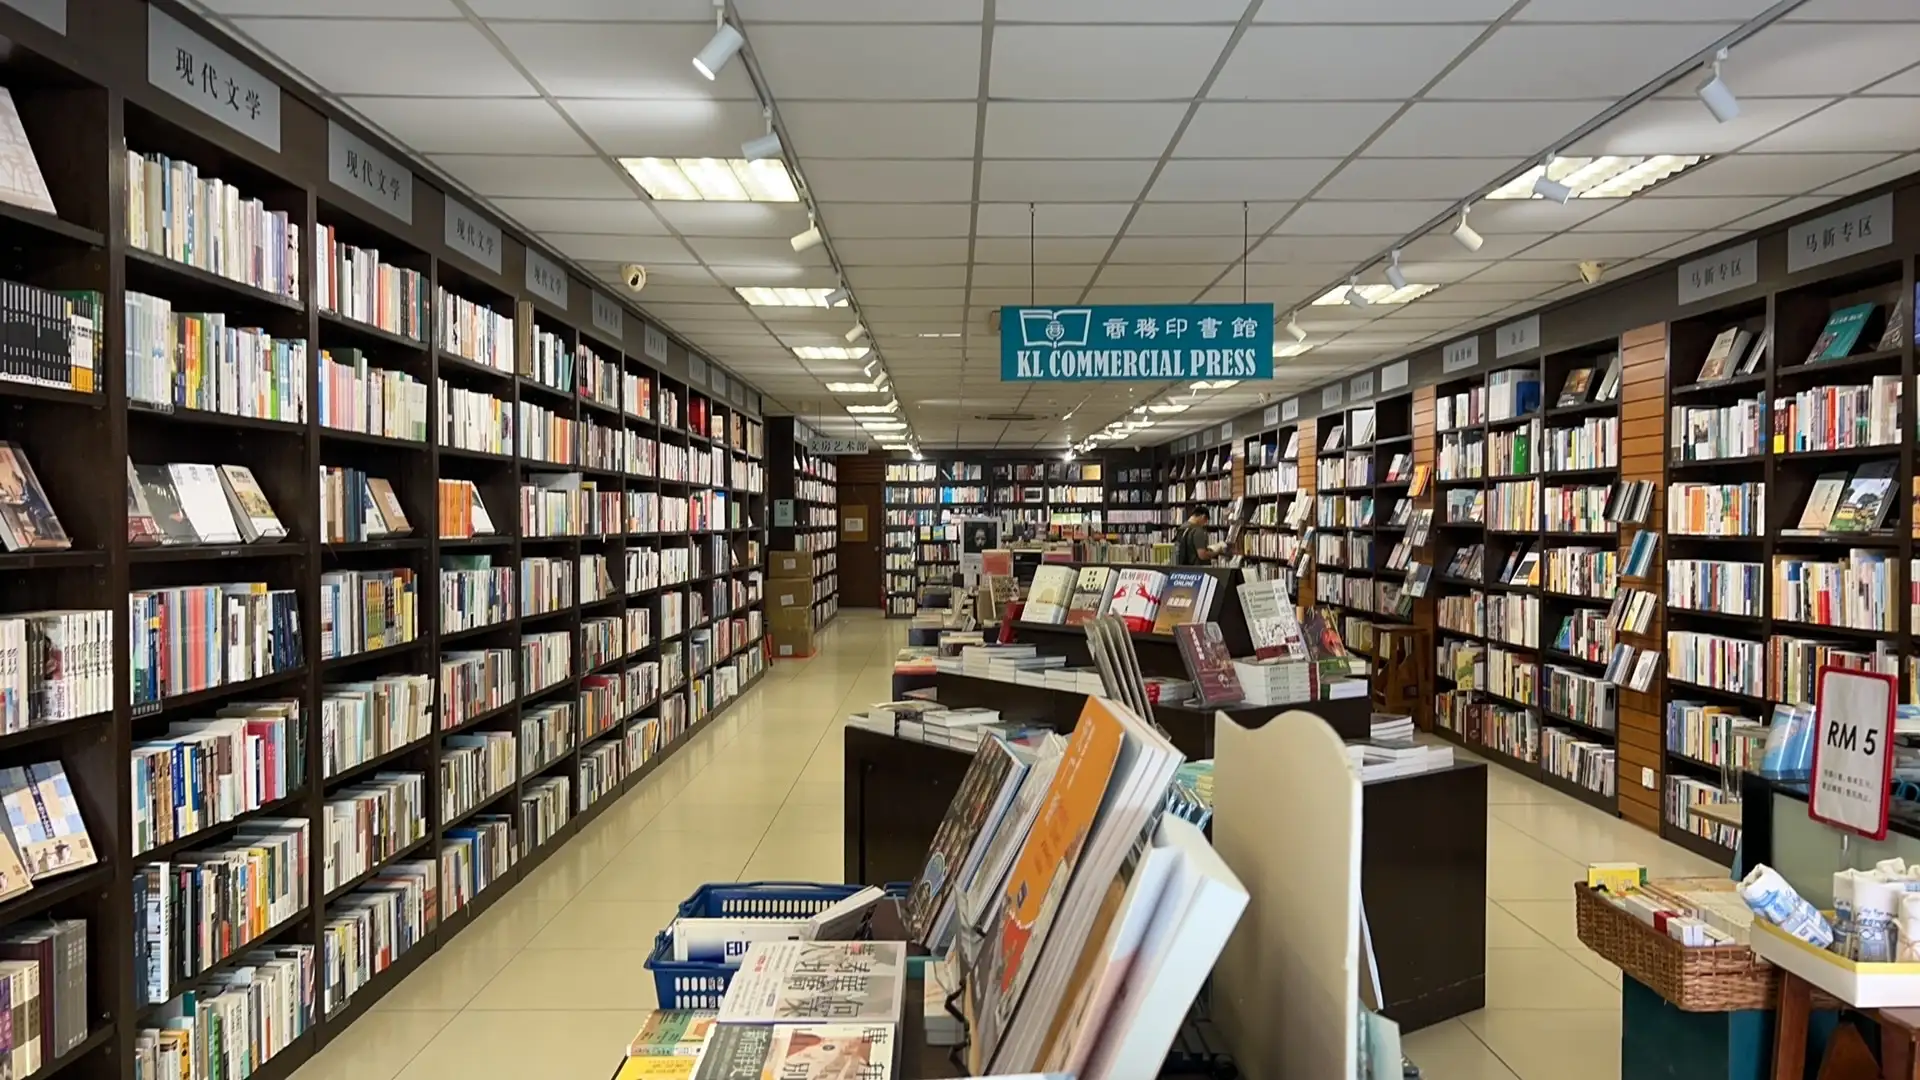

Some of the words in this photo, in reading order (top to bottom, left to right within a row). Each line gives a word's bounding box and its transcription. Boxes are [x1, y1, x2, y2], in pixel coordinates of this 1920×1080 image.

[175, 47, 261, 120] 现代文学
[346, 150, 400, 201] 现代文学
[456, 217, 495, 257] 现代文学
[1806, 215, 1873, 252] 马新专区
[1691, 258, 1742, 289] 马新专区
[1103, 316, 1258, 340] 商務印書館
[1017, 350, 1043, 378] KL
[1050, 350, 1184, 378] COMMERCIAL
[1190, 348, 1257, 377] PRESS
[1170, 573, 1203, 581] EXTREMELY
[1827, 720, 1857, 752] RM
[1863, 728, 1879, 756] 5
